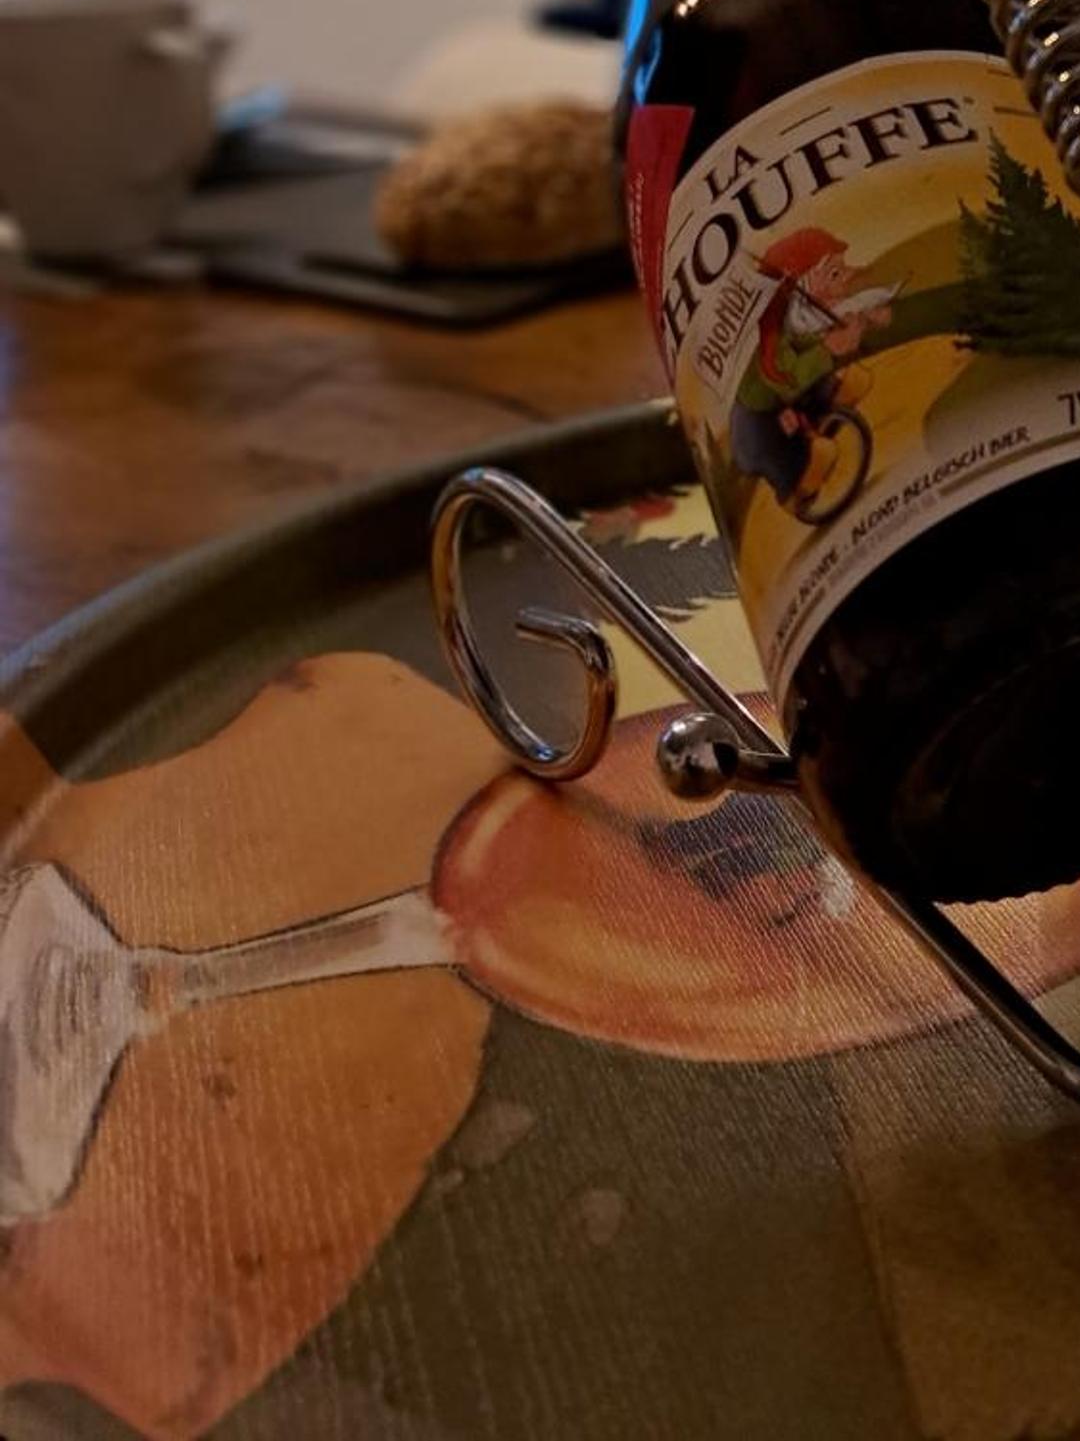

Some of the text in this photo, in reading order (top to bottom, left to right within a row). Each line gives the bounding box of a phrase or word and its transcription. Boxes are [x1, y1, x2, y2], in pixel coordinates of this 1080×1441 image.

[663, 97, 978, 353] HOUFFE
[704, 145, 760, 204] LA
[697, 275, 754, 380] BLONDE
